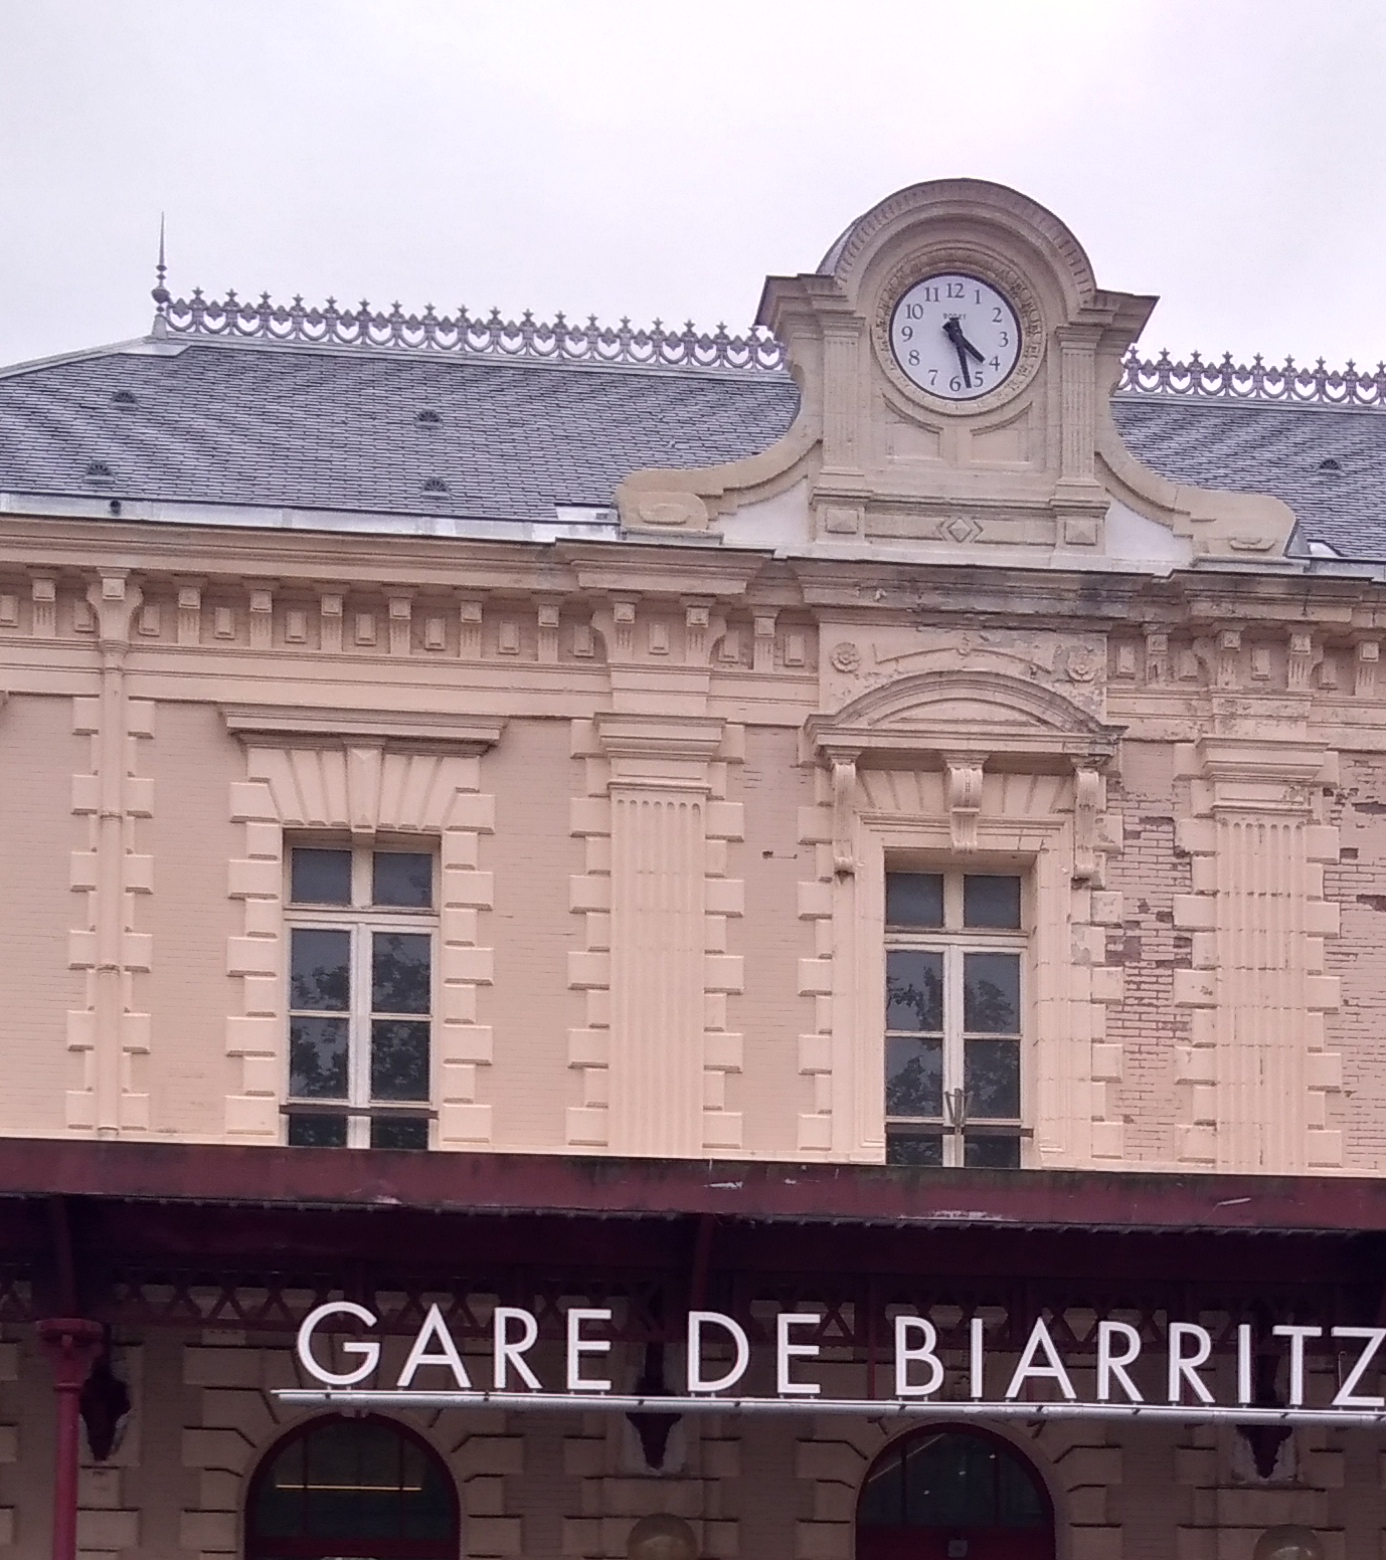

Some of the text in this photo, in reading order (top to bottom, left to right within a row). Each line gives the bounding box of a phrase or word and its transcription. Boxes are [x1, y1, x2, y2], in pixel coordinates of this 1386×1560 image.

[924, 287, 940, 302] 11
[946, 283, 965, 299] 12
[975, 289, 981, 304] 1
[905, 303, 924, 320] 10
[992, 307, 1003, 323] 2
[901, 326, 914, 342] 9
[998, 331, 1009, 347] 3
[908, 350, 921, 366] 8
[988, 356, 1001, 371] 4
[928, 369, 939, 386] 7
[949, 376, 962, 392] 6
[974, 371, 984, 387] 5
[297, 1301, 612, 1391] GARE
[687, 1310, 821, 1395] DE
